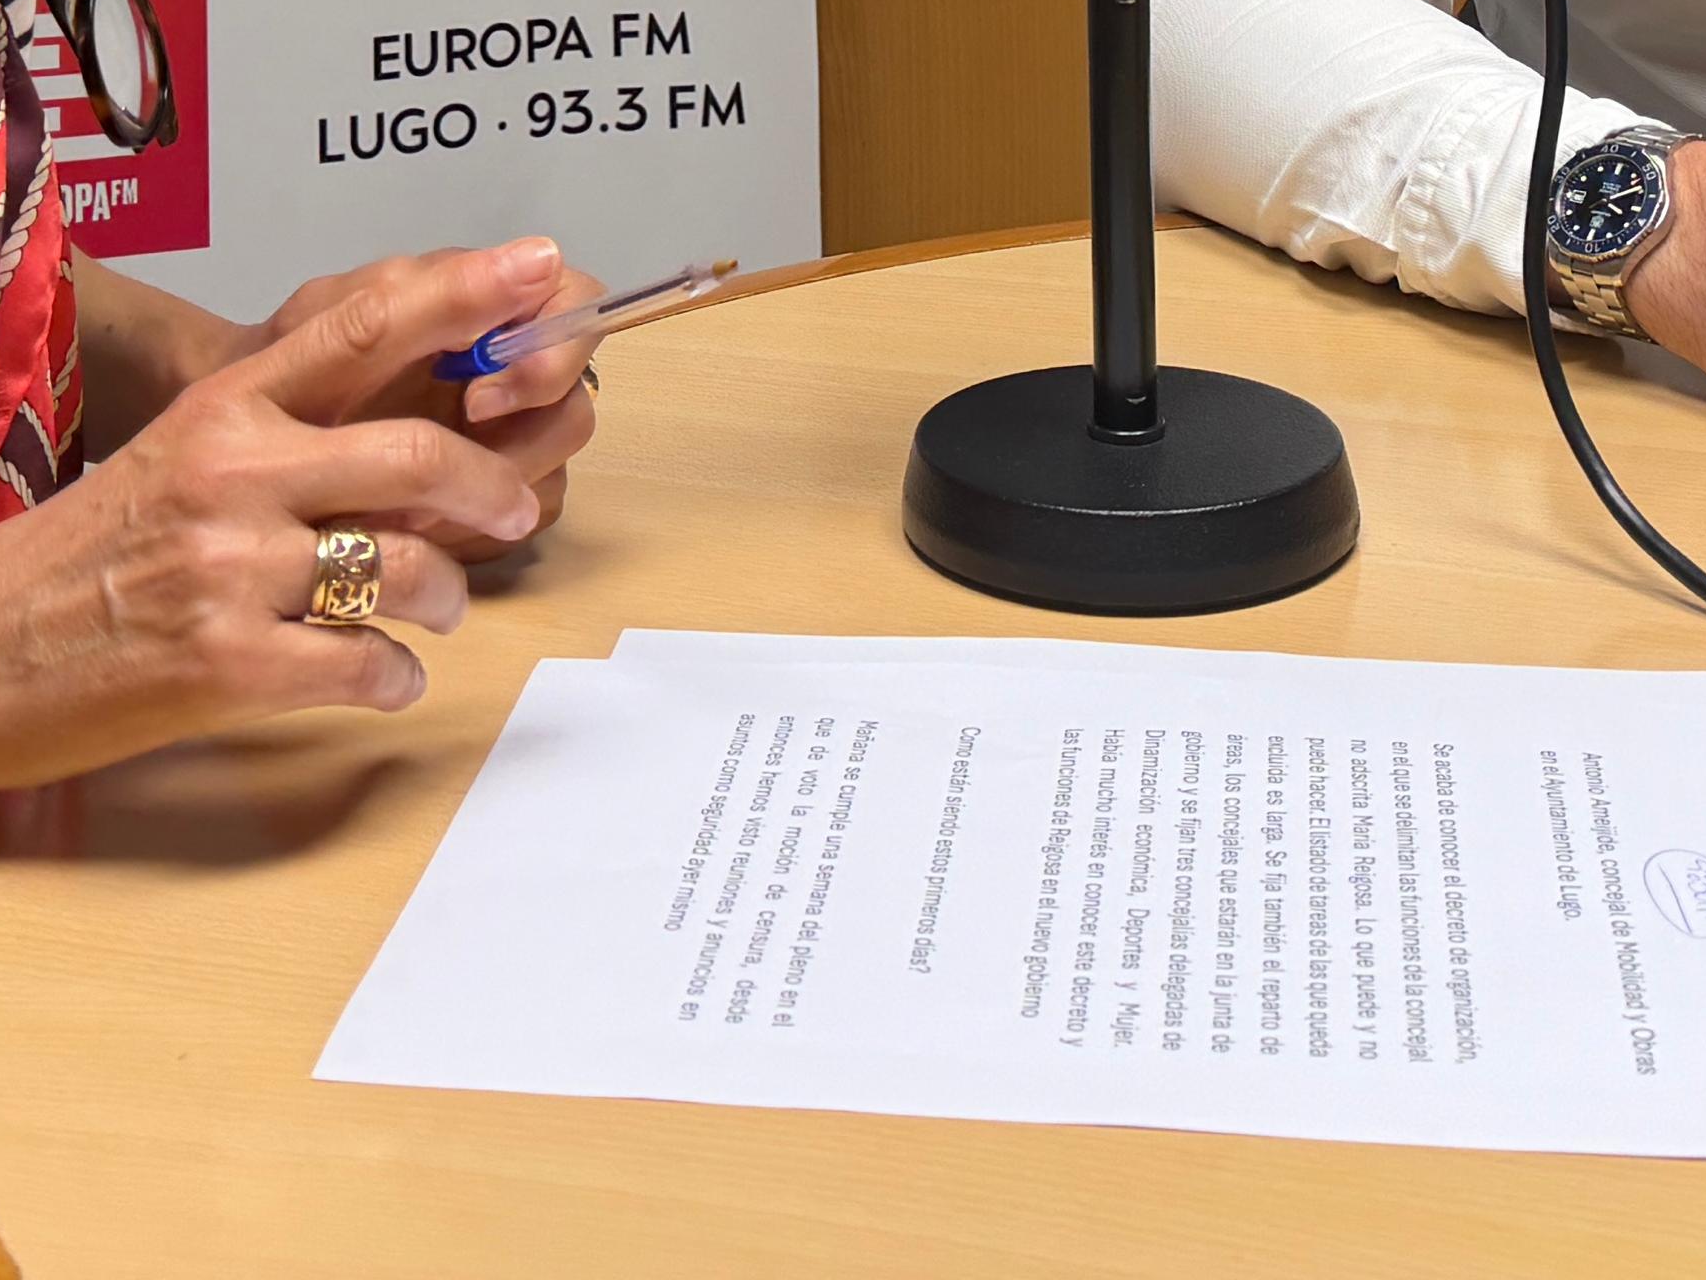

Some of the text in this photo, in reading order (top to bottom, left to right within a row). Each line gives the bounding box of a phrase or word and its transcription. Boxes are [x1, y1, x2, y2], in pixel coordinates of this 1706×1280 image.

[374, 12, 690, 81] EUROPA FM
[319, 82, 745, 163] LUGO 93.3 FM
[1350, 739, 1367, 754] no
[1095, 768, 1118, 813] mucho
[1223, 773, 1247, 793] los
[1350, 757, 1374, 809] adscrita
[1582, 752, 1609, 796] Antonio
[1089, 816, 1117, 859] interés
[1216, 797, 1245, 866] concejales
[1539, 750, 1583, 922] en el Ayuntamiento de Lugo.
[1020, 728, 1085, 1019] las funciones de Reigosa en el nuevo gobierno
[1087, 862, 1106, 879] en
[1109, 729, 1167, 1048] Dinamización económica, Deportes y Mujer.
[1160, 730, 1206, 1052] gobierno y se fijan tres concejalías delegadas de
[1215, 869, 1238, 894] que
[1347, 855, 1377, 911] Reigosa.
[1600, 858, 1632, 917] concejal
[1079, 882, 1103, 938] conocer
[1256, 735, 1289, 1056] excluida es larga. Se fija también el reparto de
[1304, 736, 1333, 1058] puede hacer. El listado de tareas de las que queda
[1388, 741, 1434, 1063] en el que se delimitan las funciones de la concejal
[1432, 743, 1482, 1065] Se acaba de conocer el decreto de organización,
[1217, 897, 1241, 948] estarán
[1354, 917, 1378, 936] Lo
[1610, 919, 1635, 938] de
[1073, 941, 1096, 972] este
[1215, 952, 1235, 971] en
[1350, 941, 1375, 969] que
[1615, 941, 1650, 1010] Mobilidad
[1214, 974, 1238, 988] la
[1351, 973, 1381, 1019] puede
[1066, 976, 1095, 1033] decreto
[1208, 990, 1238, 1030] junta
[1622, 1013, 1647, 1024] y
[1059, 1037, 1083, 1048] y
[1210, 1033, 1236, 1054] de
[1351, 1024, 1377, 1035] y
[1358, 1040, 1379, 1061] no
[1629, 1027, 1657, 1076] Obras
